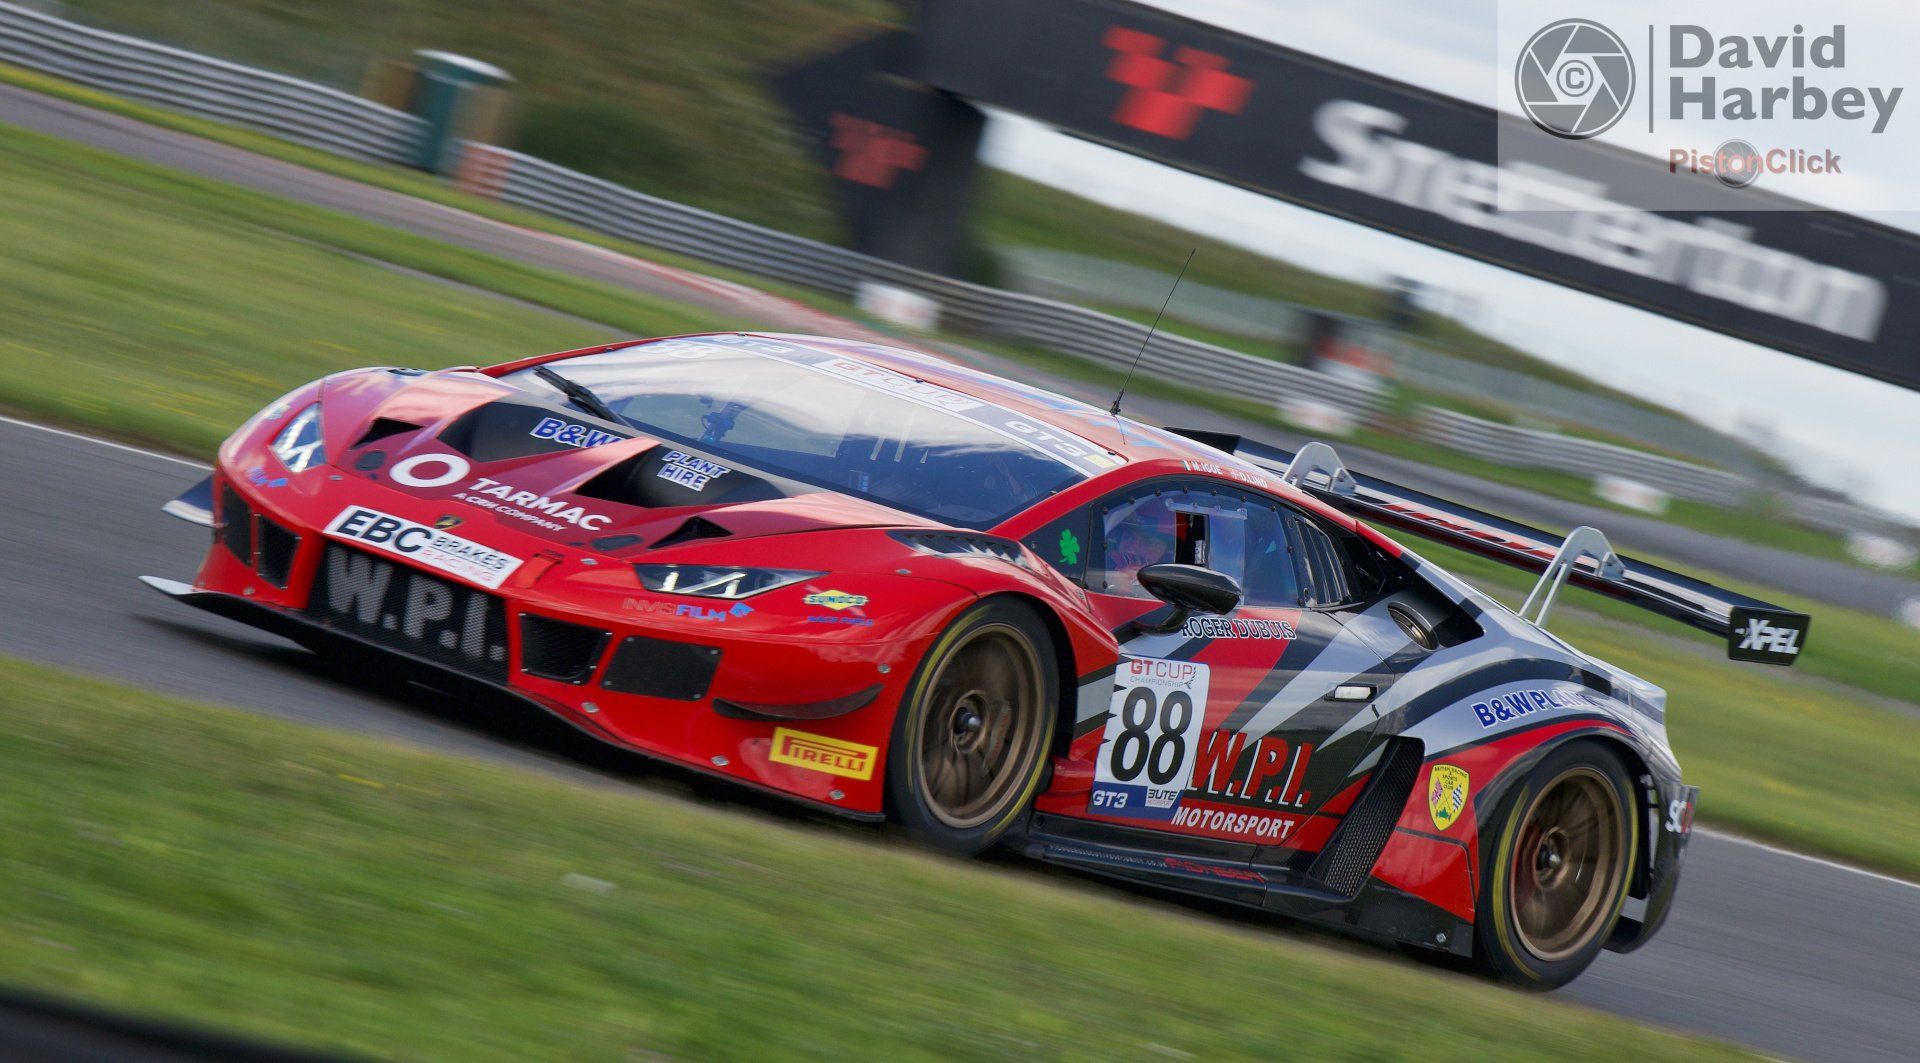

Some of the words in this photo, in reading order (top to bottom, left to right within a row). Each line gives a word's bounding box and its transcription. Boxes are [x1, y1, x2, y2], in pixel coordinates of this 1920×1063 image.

[1004, 419, 1088, 458] GT3
[657, 463, 711, 491] HIRE
[662, 450, 731, 479] PLANT
[468, 477, 613, 531] TARMAC
[495, 505, 568, 531] COMPANY
[336, 509, 433, 553] EBC
[431, 536, 509, 570] BRAKES
[327, 544, 507, 662] W.P.I.
[1182, 617, 1236, 639] ROGER
[1233, 618, 1297, 640] DUBUIS
[1736, 618, 1800, 655] XPEL
[1129, 675, 1184, 688] CHAMPIONSHIP
[1130, 658, 1154, 676] GT
[1156, 661, 1193, 680] CUP
[1472, 690, 1536, 728] B&W
[780, 735, 868, 772] PIRELLI
[1110, 686, 1193, 786] 88
[1188, 729, 1315, 808] W.P.I.
[1092, 789, 1129, 809] GT3
[1171, 806, 1295, 839] MOTORSPORT
